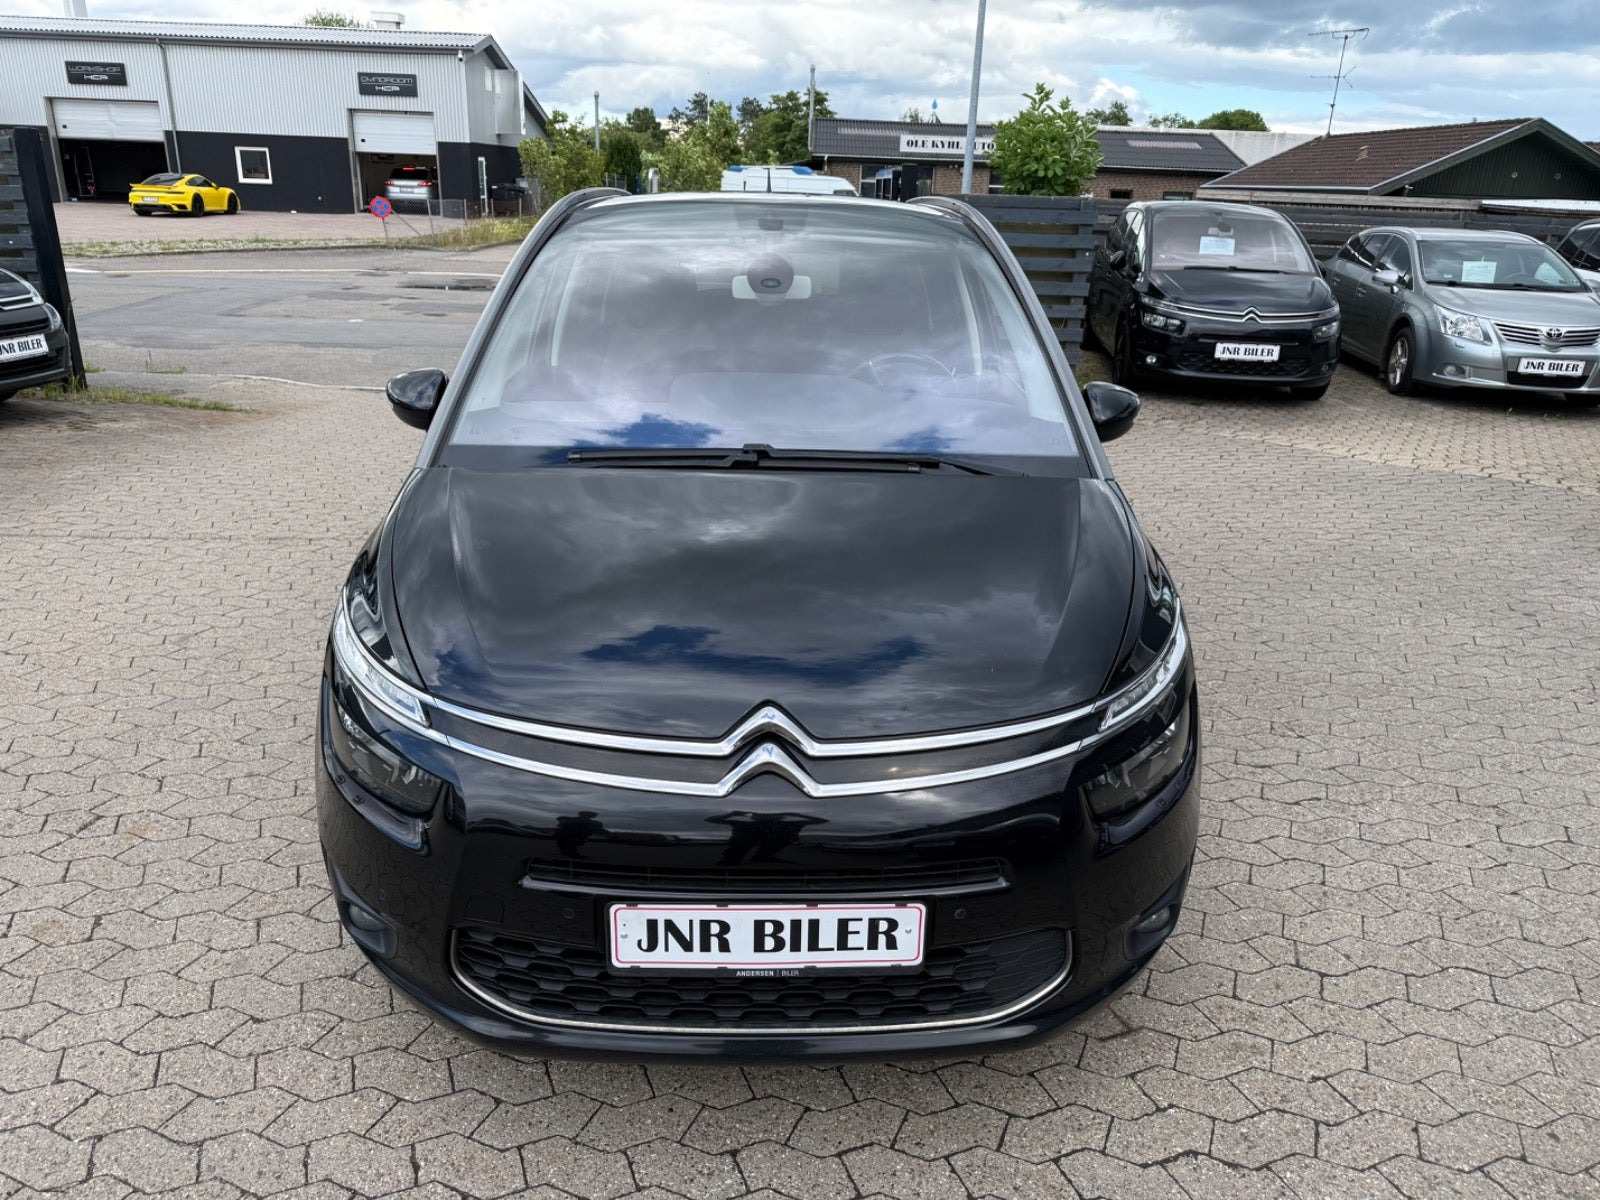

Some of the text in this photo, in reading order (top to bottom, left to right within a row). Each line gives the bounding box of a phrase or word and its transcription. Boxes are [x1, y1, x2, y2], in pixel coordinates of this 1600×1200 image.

[906, 139, 928, 149] OLE
[973, 141, 996, 151] UTO
[17, 338, 43, 352] BILER
[1220, 346, 1275, 357] JNR BILER
[1525, 361, 1580, 372] JNR BILER
[637, 917, 899, 953] JNR BILER
[781, 969, 800, 977] BILER
